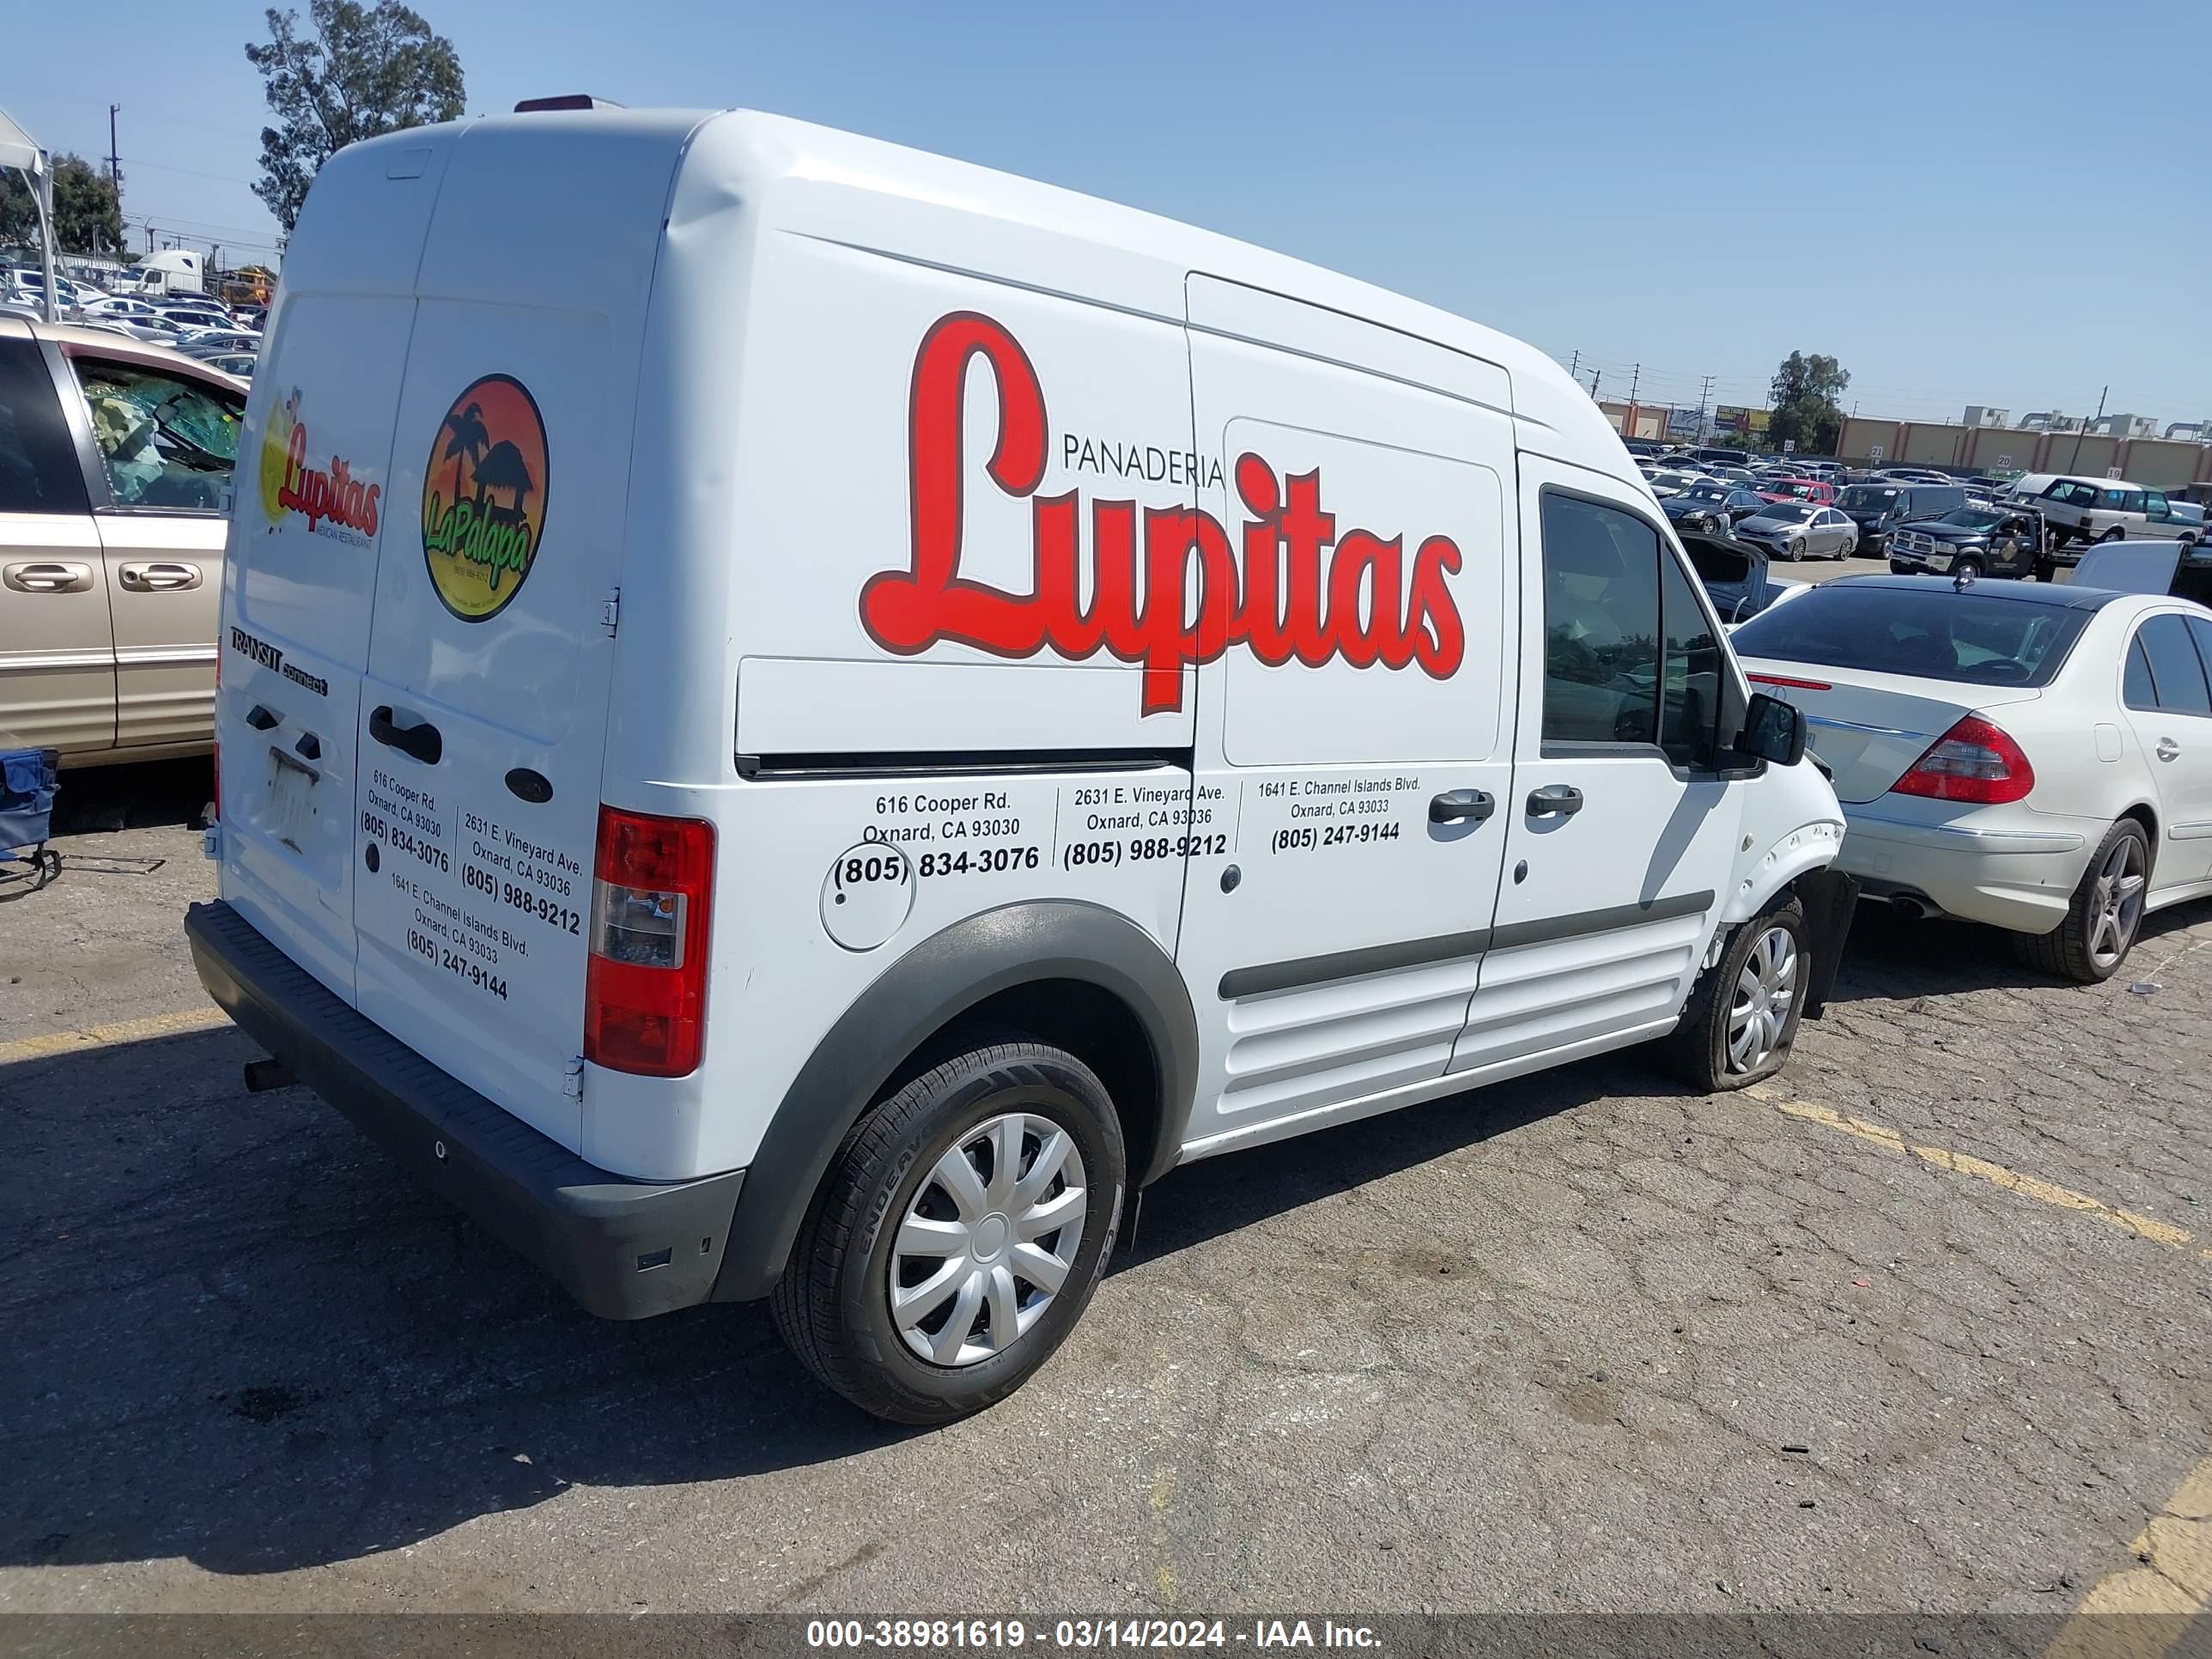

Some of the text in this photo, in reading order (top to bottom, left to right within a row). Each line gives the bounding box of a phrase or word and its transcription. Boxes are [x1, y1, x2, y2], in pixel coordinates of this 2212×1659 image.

[1064, 433, 1226, 490] PANADERIA
[1872, 447, 1881, 456] 21
[1998, 457, 2010, 466] 20
[2109, 468, 2120, 477] 19
[278, 422, 381, 538] Lupitas
[859, 310, 1465, 718] Lupitas
[315, 524, 373, 550] MEXICAN RESTAURANT
[230, 625, 329, 698] TRANSIT connect
[374, 769, 437, 812] 616 Cooper Rd.
[876, 792, 1012, 816] 616 Cooper Rd.
[1074, 785, 1225, 805] 2631 E. Vineyard Ave.
[1258, 776, 1421, 797] 1641 E. Channel Islands Blvd.
[368, 789, 441, 838] Oxnard, CA 93030
[1087, 809, 1212, 830] Oxnard, CA 93036
[1291, 799, 1389, 818] Oxnard, CA 93033
[361, 810, 449, 873] (805) 834-3076
[465, 812, 584, 878] 2631 E. Vineyard Ave.
[863, 818, 1020, 843] Oxnard, CA 93030
[1272, 822, 1401, 855] (805) 247-9144
[472, 840, 571, 897] Oxnard, CA 93036
[834, 847, 1040, 890] (805) 834-3076
[1064, 834, 1227, 872] (805) 988-9212
[391, 872, 530, 958] 1641 E. Channel Islands Blvd.
[461, 862, 580, 936] (805) 988-9212
[415, 907, 499, 965] Oxnard, CA 93033
[406, 927, 508, 1001] (805) 247-9144
